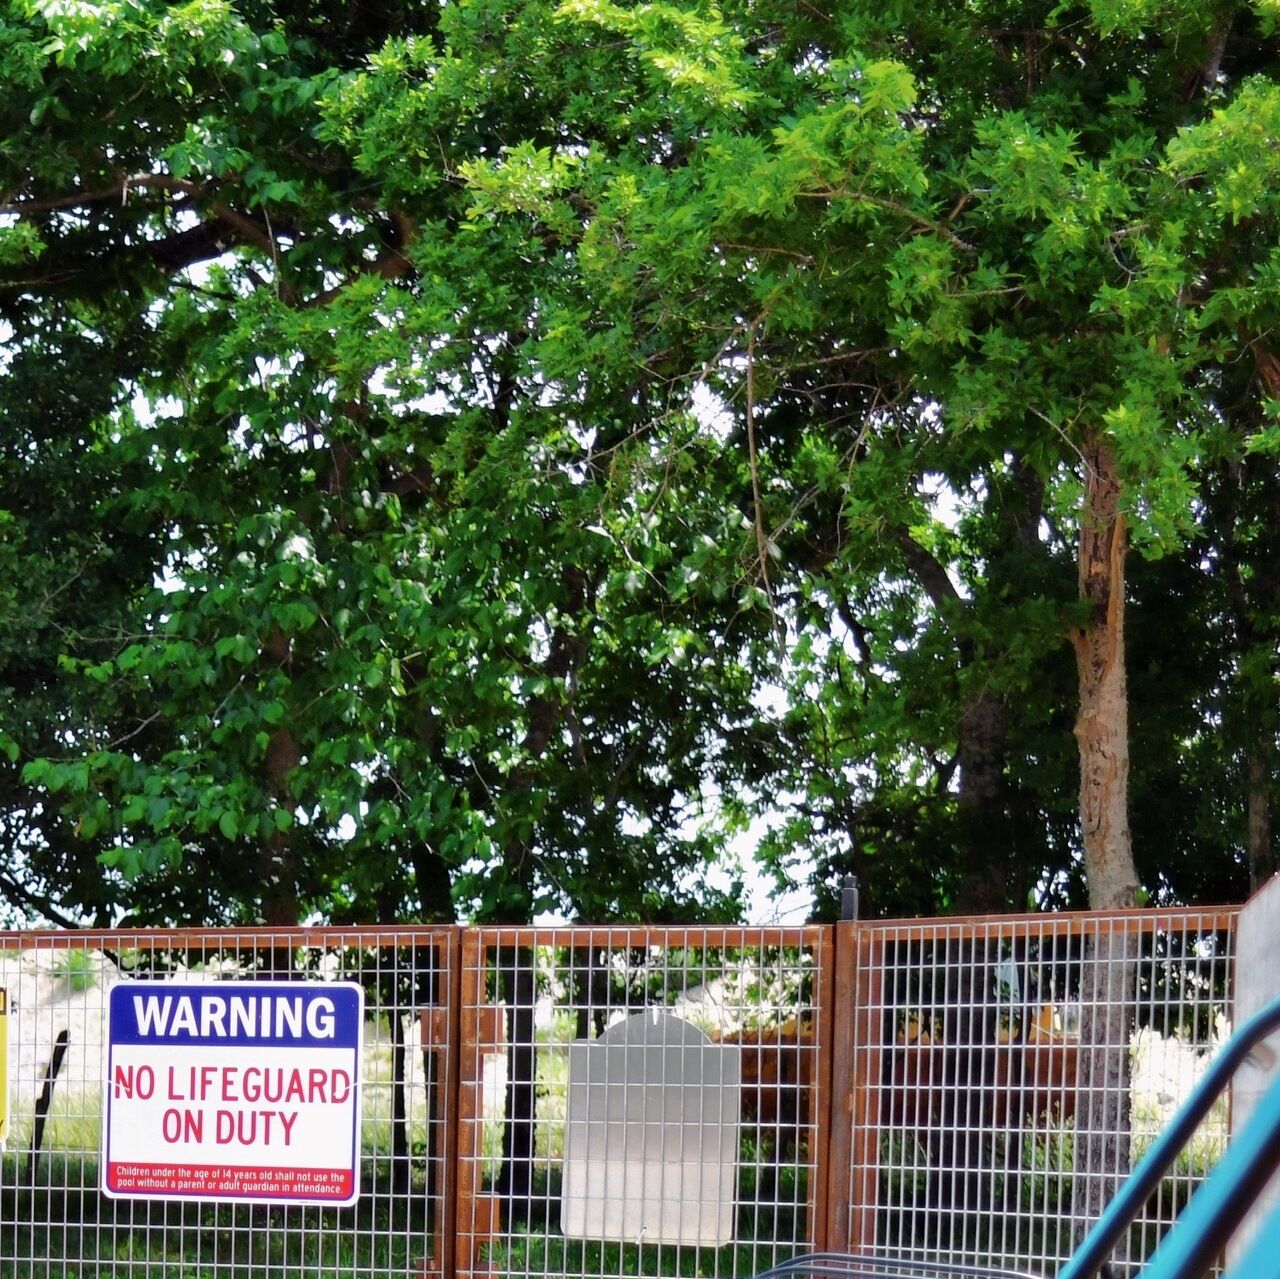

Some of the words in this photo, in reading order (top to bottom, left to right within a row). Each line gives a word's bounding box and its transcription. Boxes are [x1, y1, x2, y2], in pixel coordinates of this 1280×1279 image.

[133, 996, 335, 1039] WARNING
[115, 1065, 154, 1100] NO
[169, 1066, 350, 1104] LIFEGUARD
[163, 1109, 203, 1143] ON
[216, 1110, 298, 1145] DUTY
[117, 1166, 149, 1176] Children
[152, 1168, 175, 1176] under
[179, 1169, 191, 1177] the
[194, 1171, 208, 1180] age
[212, 1169, 219, 1178] of
[223, 1170, 231, 1178] 14
[234, 1171, 256, 1179] years
[260, 1171, 272, 1179] old
[275, 1171, 294, 1180] shall
[297, 1173, 310, 1181] not
[314, 1174, 327, 1182] use
[331, 1173, 344, 1182] the
[118, 1179, 135, 1188] pool
[138, 1179, 167, 1187] without
[178, 1181, 204, 1190] parent
[219, 1181, 239, 1190] adult
[243, 1182, 279, 1193] guardian
[282, 1183, 289, 1191] in
[293, 1183, 342, 1193] attendance.
